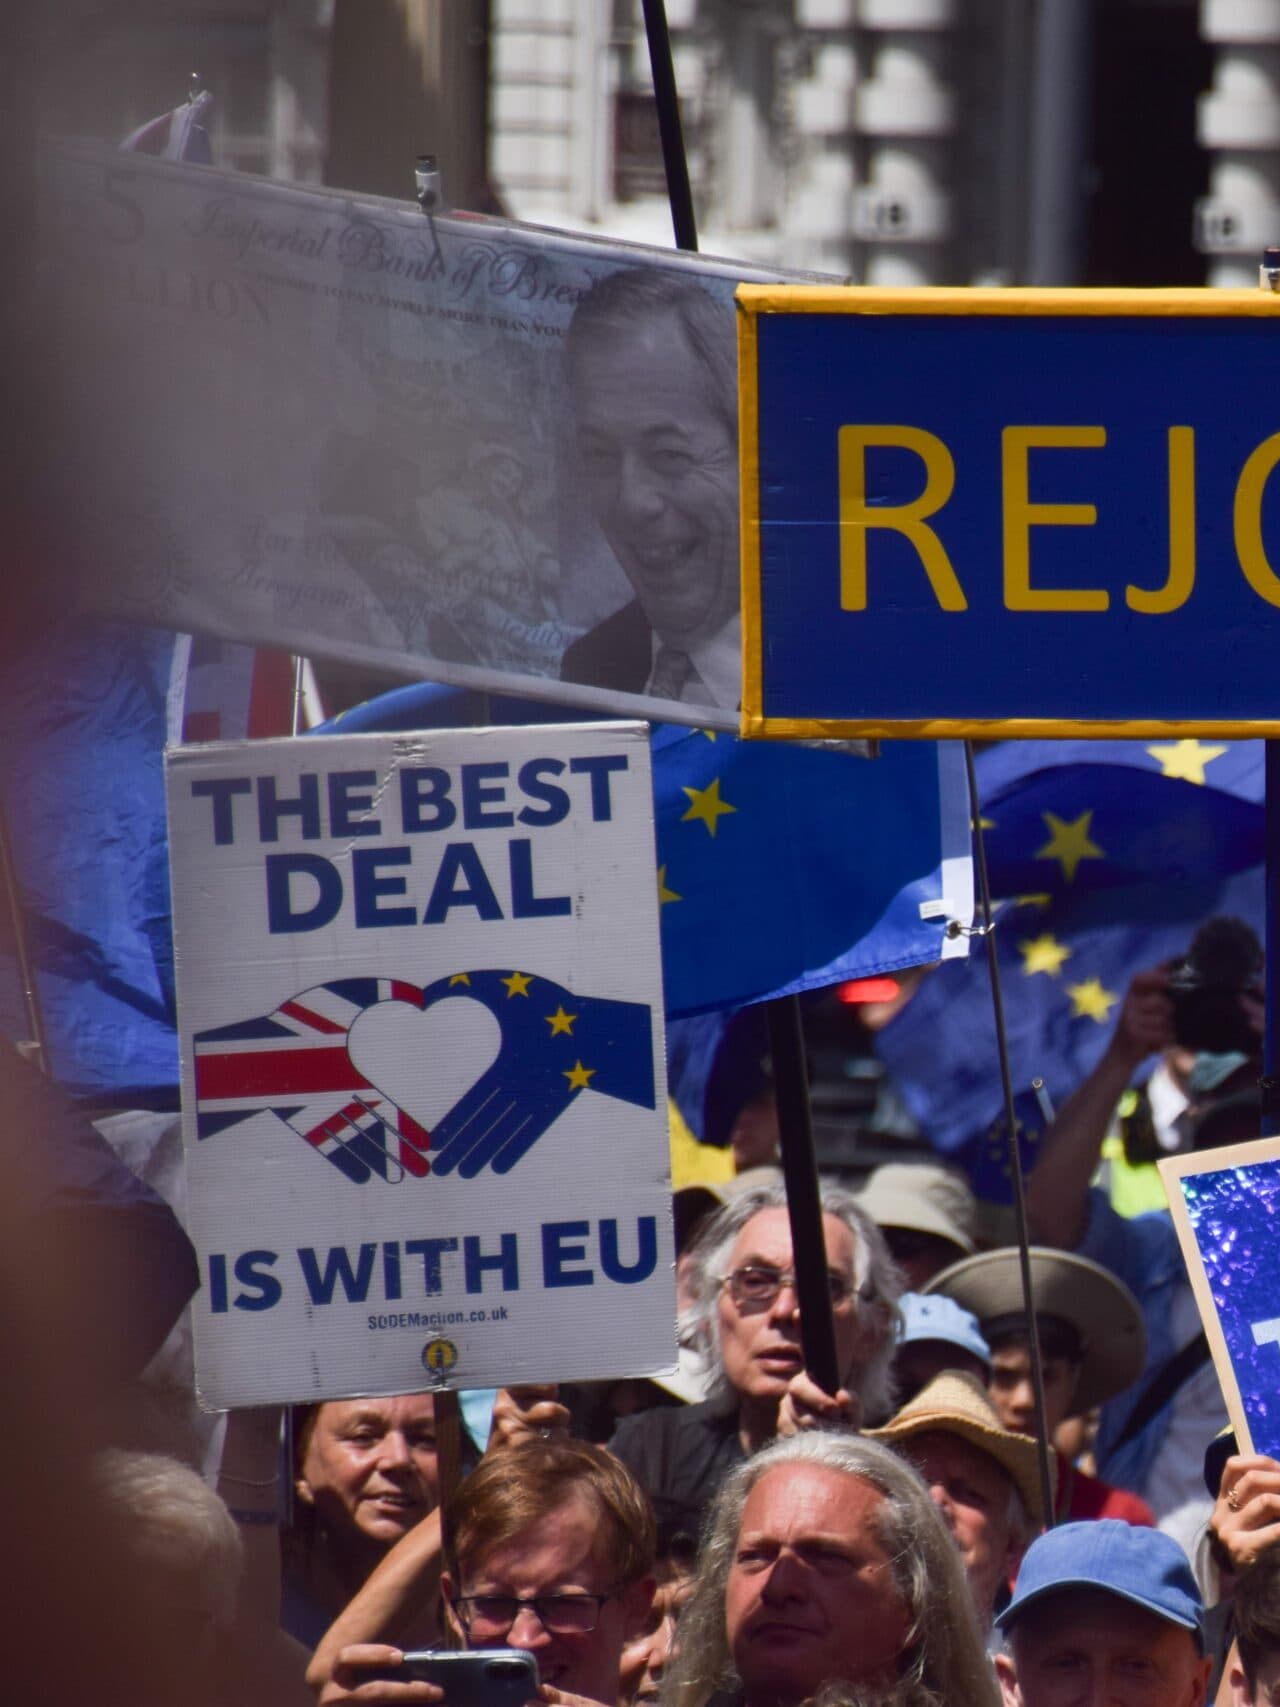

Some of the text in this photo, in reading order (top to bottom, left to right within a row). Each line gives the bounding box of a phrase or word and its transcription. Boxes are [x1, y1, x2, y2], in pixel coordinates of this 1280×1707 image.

[181, 196, 332, 260] Imperial
[338, 220, 443, 284] Bank
[451, 243, 498, 299] of
[439, 308, 486, 326] MORE
[490, 315, 529, 333] THAN
[531, 322, 566, 338] YOU
[191, 754, 629, 846] THE BEST
[265, 838, 573, 935] DEAL
[207, 1215, 658, 1314] IS WITH EU
